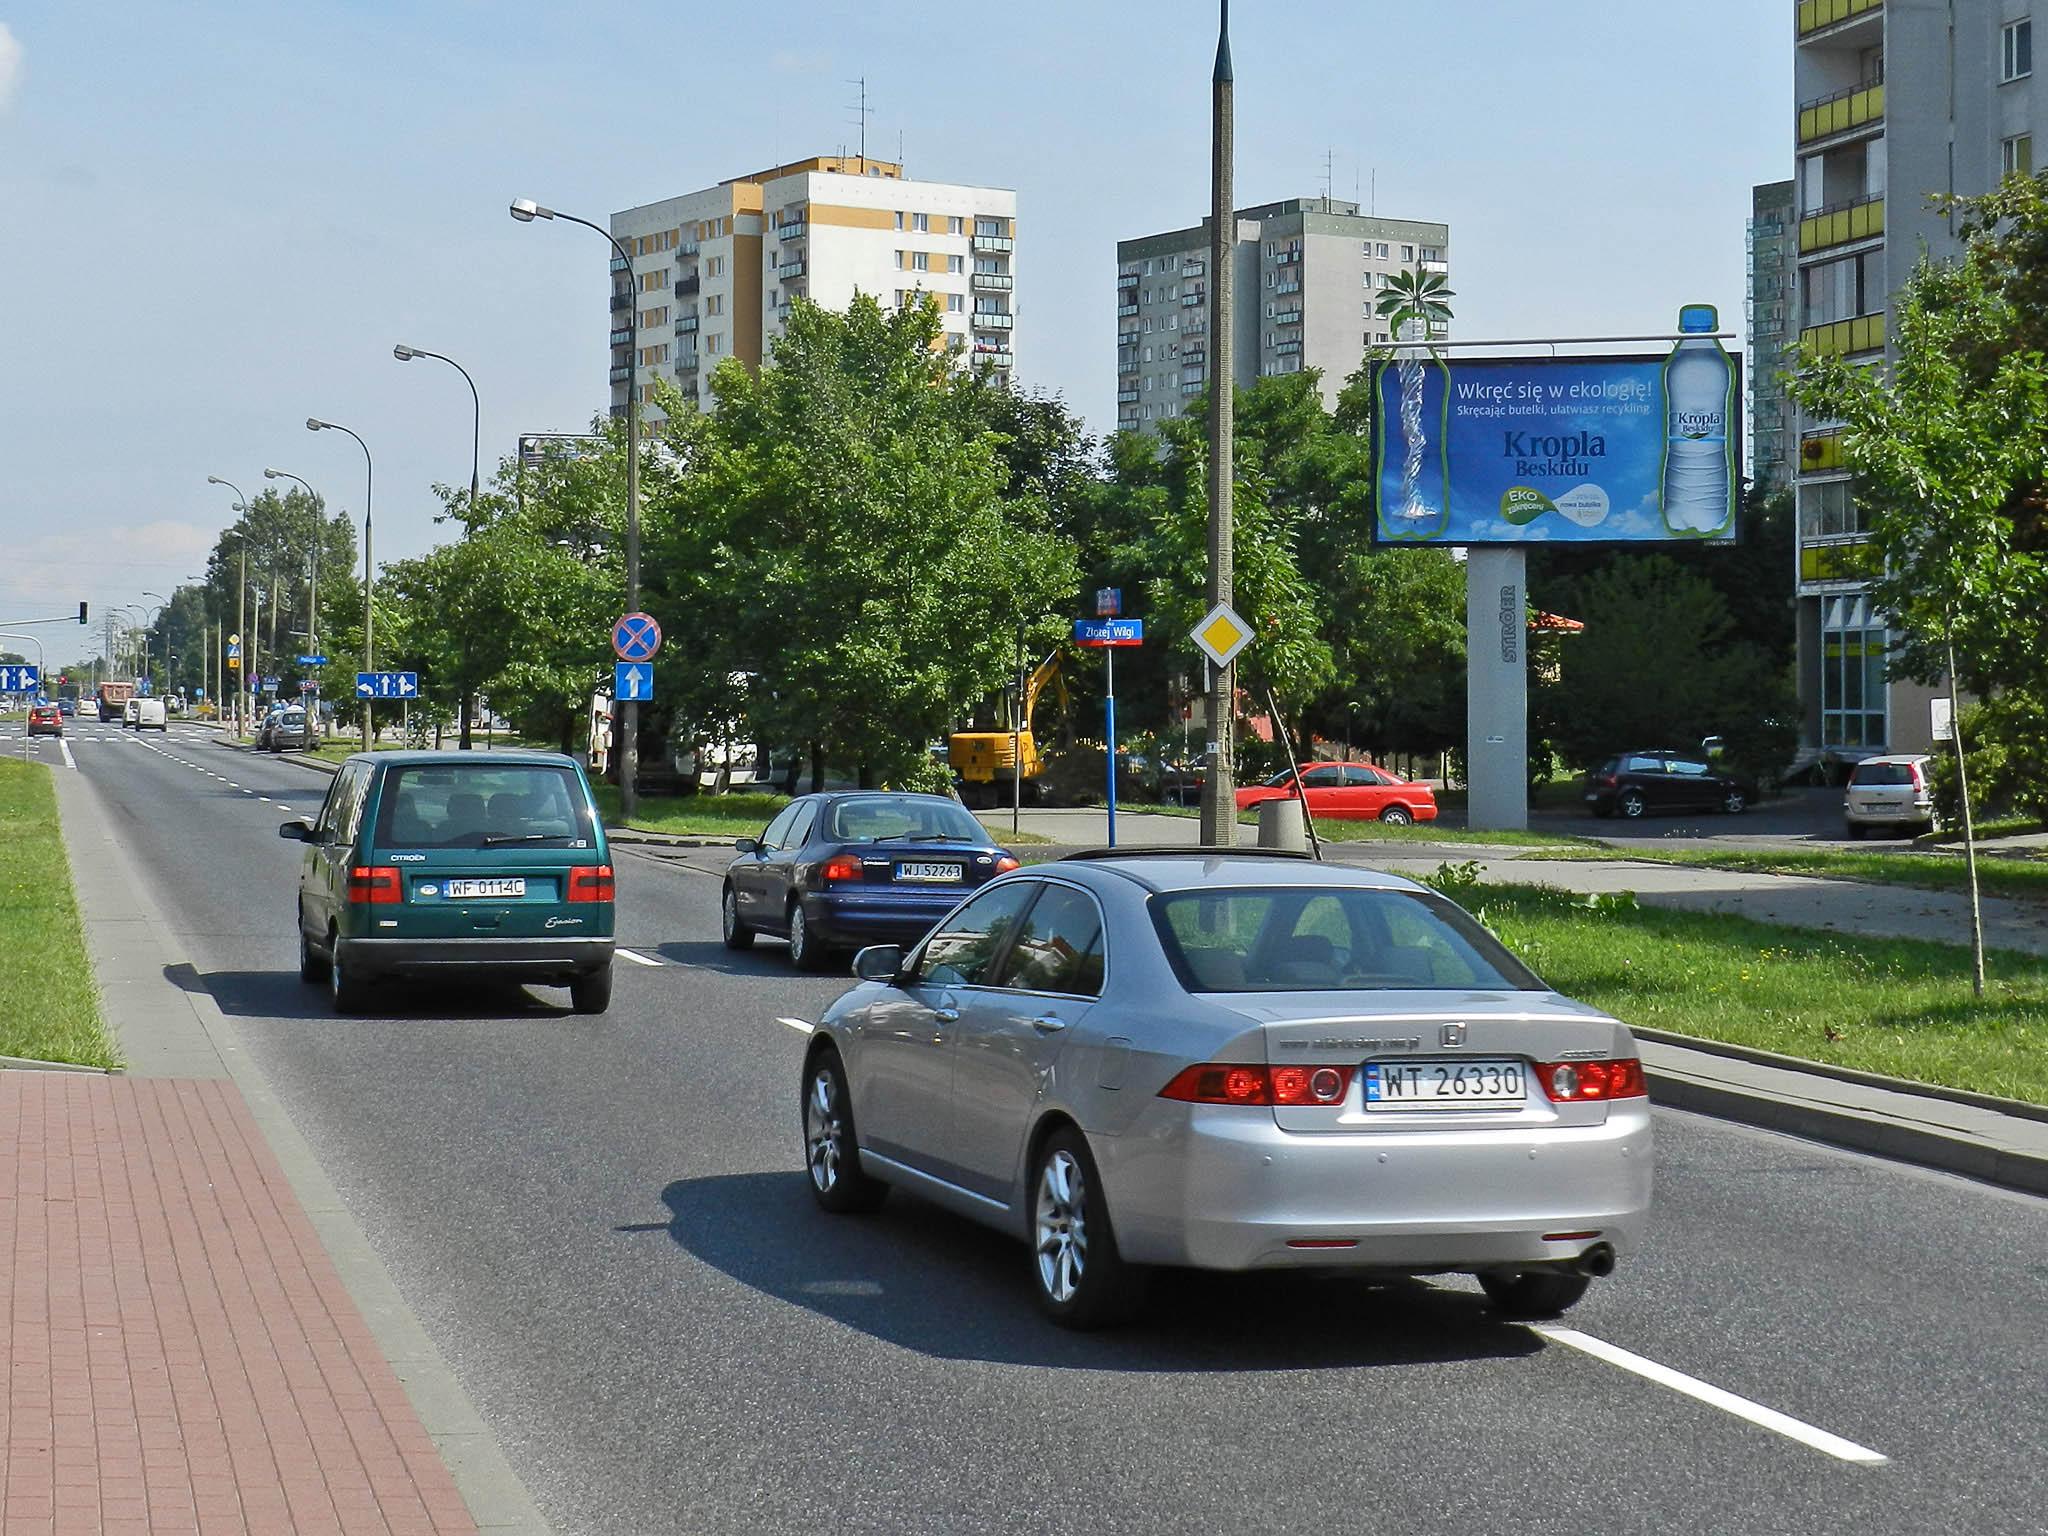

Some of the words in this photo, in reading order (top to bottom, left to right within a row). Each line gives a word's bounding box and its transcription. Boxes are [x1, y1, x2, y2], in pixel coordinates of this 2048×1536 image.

[1457, 382, 1512, 403] Wkręć
[1518, 381, 1542, 402] się
[1549, 386, 1564, 398] w
[1570, 381, 1652, 401] ekologię!
[1457, 404, 1505, 418] Skręcając
[1508, 404, 1547, 416] butelki,
[1551, 403, 1599, 415] ułatwiasz
[1678, 412, 1720, 426] Kropla
[1503, 431, 1606, 463] Kropla
[1516, 458, 1589, 477] Beskidu
[1509, 490, 1538, 502] EKO
[1113, 626, 1135, 639] Wilgi
[903, 865, 921, 876] WJ
[923, 865, 961, 877] 52263
[452, 883, 473, 896] WF
[478, 880, 524, 894] 0114C
[1384, 1067, 1423, 1097] WT
[1434, 1066, 1519, 1096] 26330
